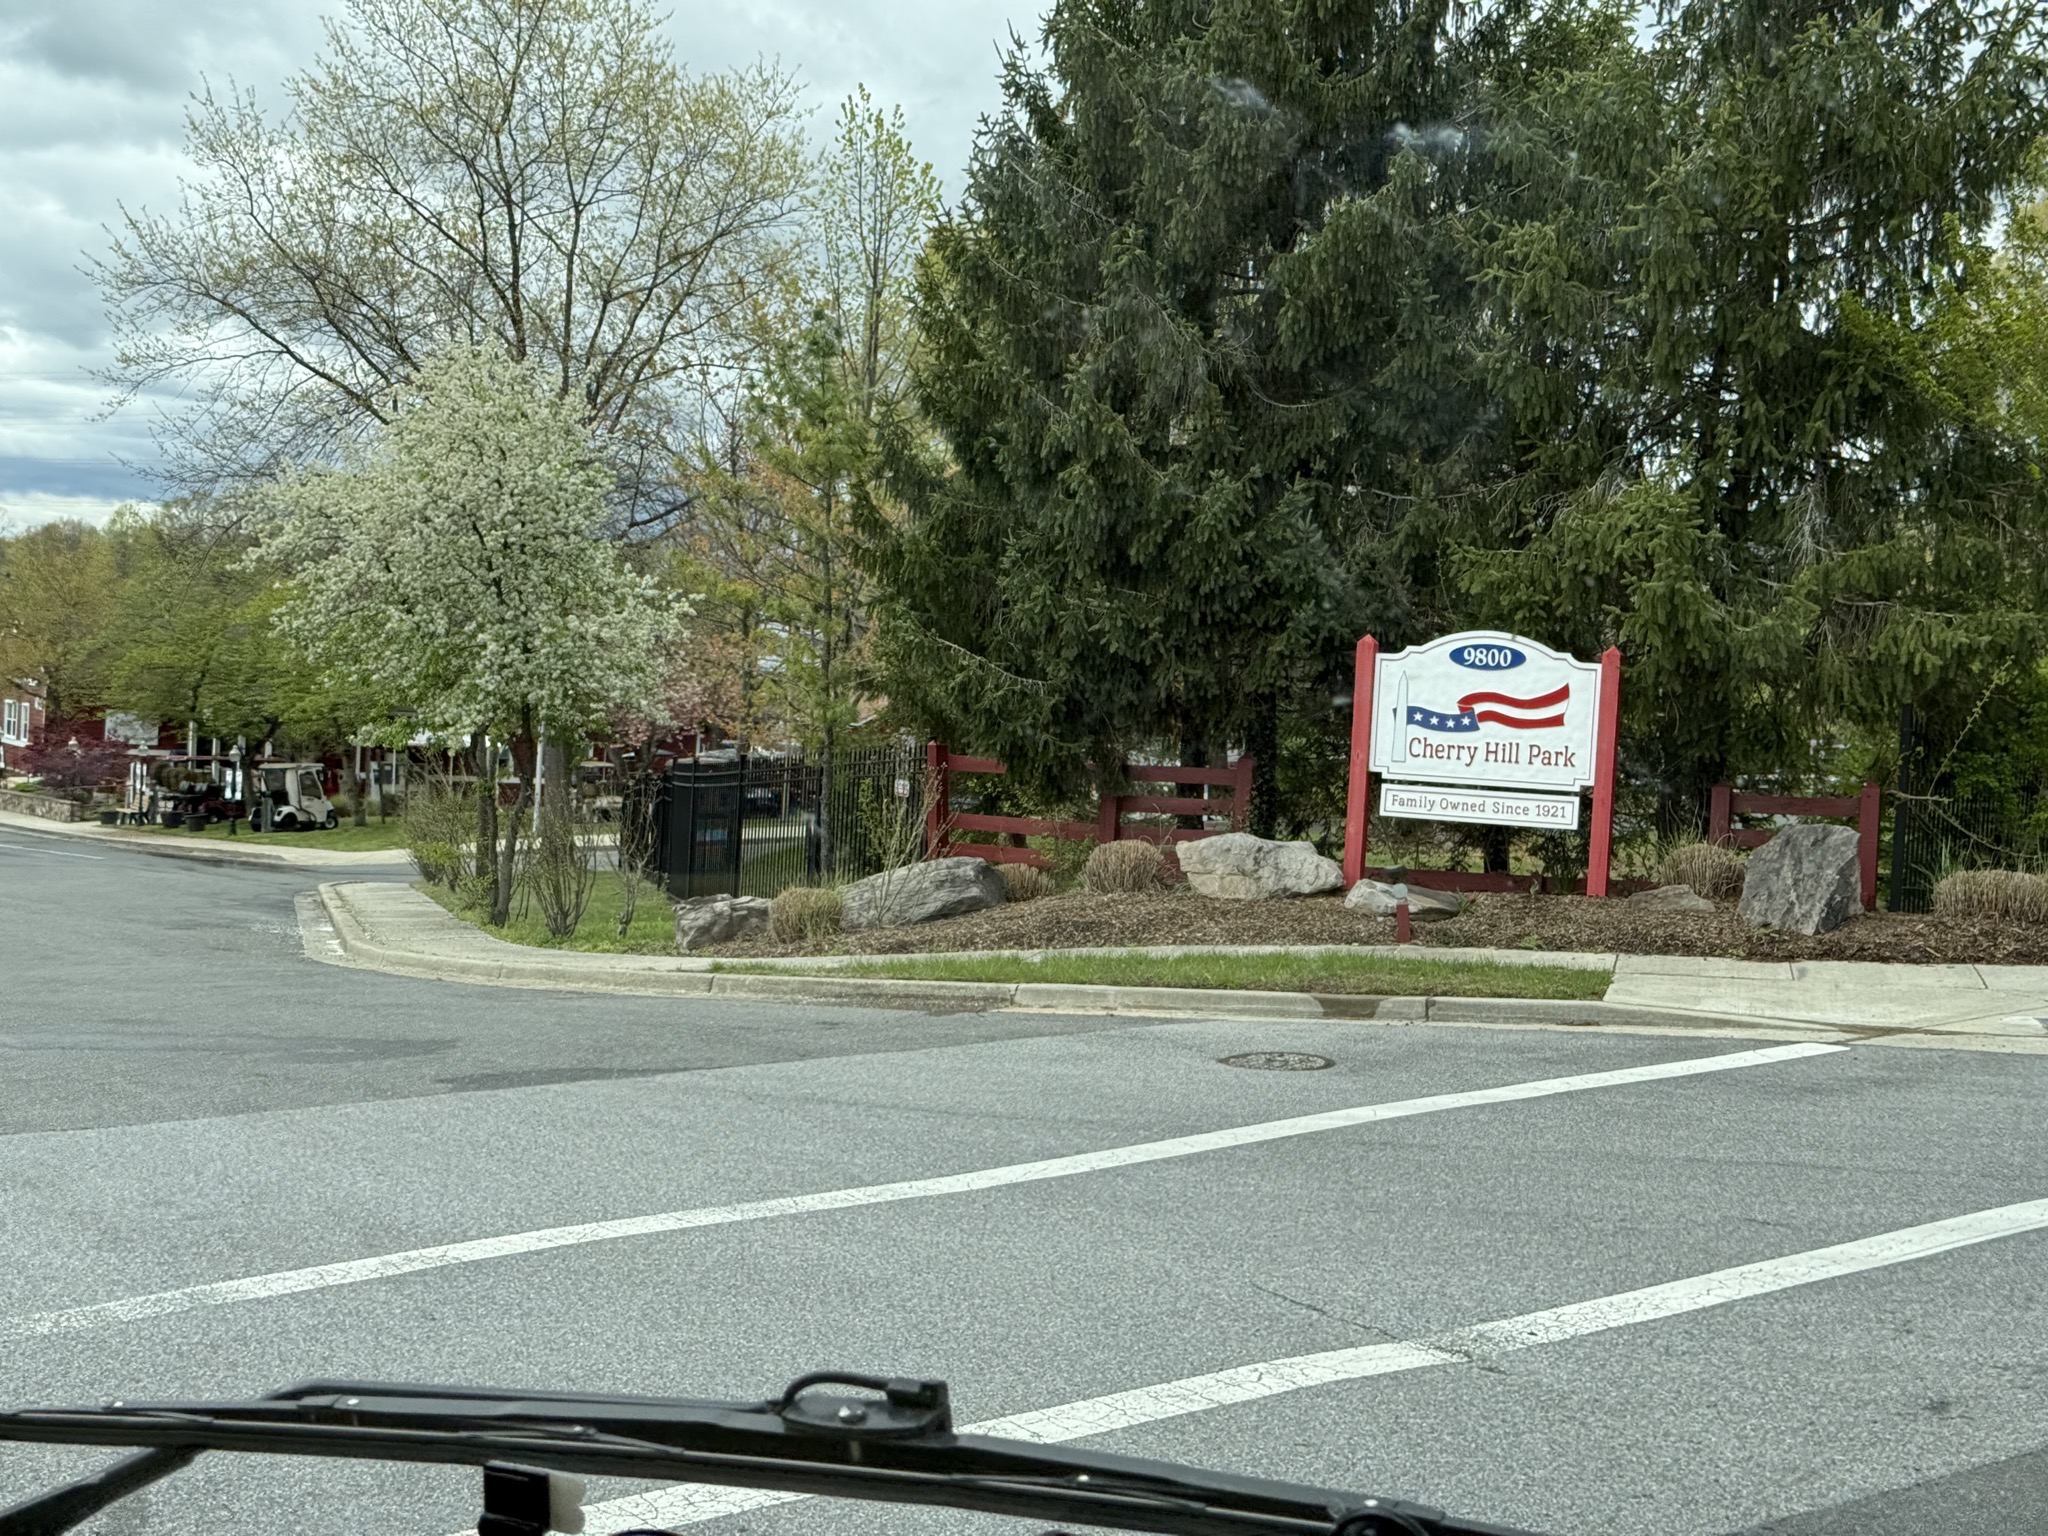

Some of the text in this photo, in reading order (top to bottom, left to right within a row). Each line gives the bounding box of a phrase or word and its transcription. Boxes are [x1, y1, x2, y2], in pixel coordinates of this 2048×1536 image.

[1463, 647, 1512, 667] 9800
[1409, 737, 1576, 767] Cherry Hill Park
[1391, 795, 1567, 818] Family Owned Since 1921
